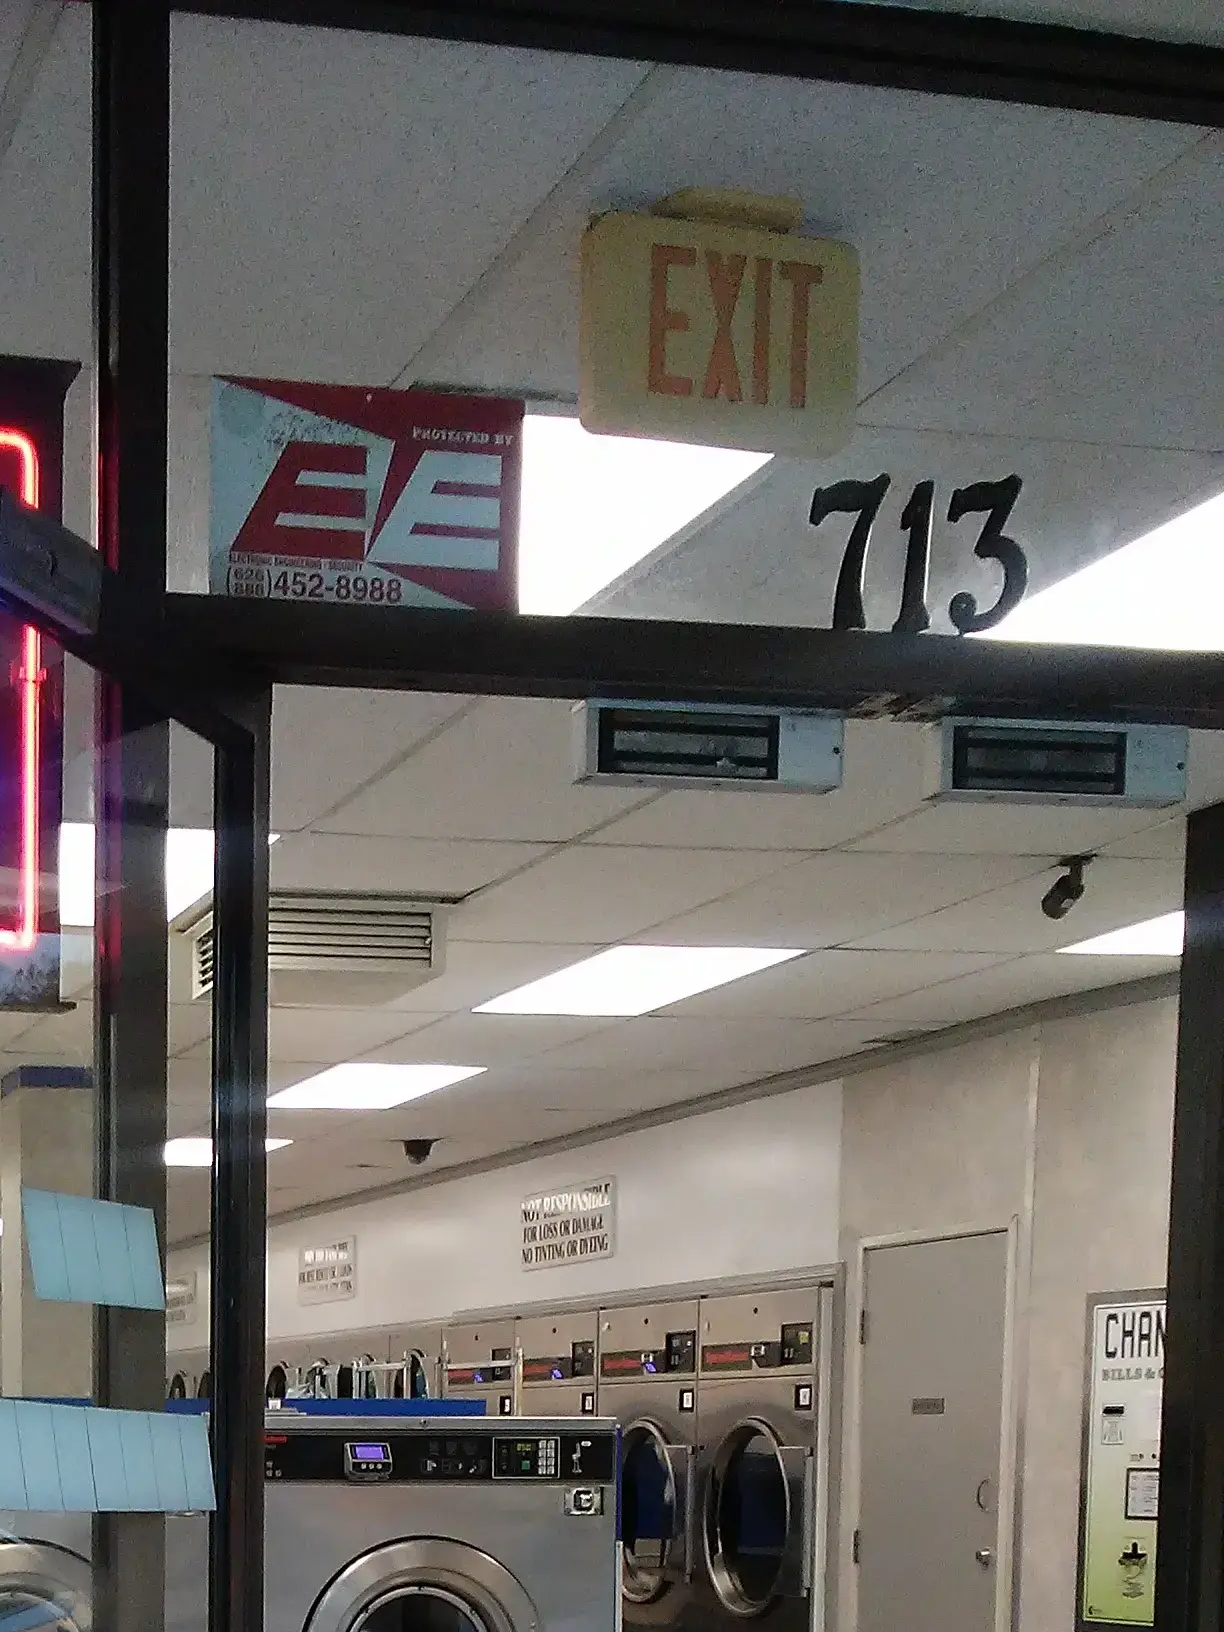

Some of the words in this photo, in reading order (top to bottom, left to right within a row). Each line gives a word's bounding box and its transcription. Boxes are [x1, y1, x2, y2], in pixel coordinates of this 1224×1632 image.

[647, 243, 823, 409] EXIT
[412, 425, 490, 444] PROTECTED
[494, 432, 514, 446] BY
[809, 472, 1029, 637] 713
[521, 1199, 543, 1223] NOT
[543, 1183, 612, 1219] RESPONSIBLE
[523, 1226, 537, 1244] FOR
[539, 1222, 558, 1241] LOSS
[559, 1219, 571, 1237] OR
[572, 1213, 605, 1235] DAMAGE
[522, 1247, 533, 1264] NO
[534, 1242, 565, 1263] TINTING
[567, 1240, 578, 1257] OR
[1101, 1367, 1143, 1381] BILLS
[1144, 1367, 1156, 1380] &
